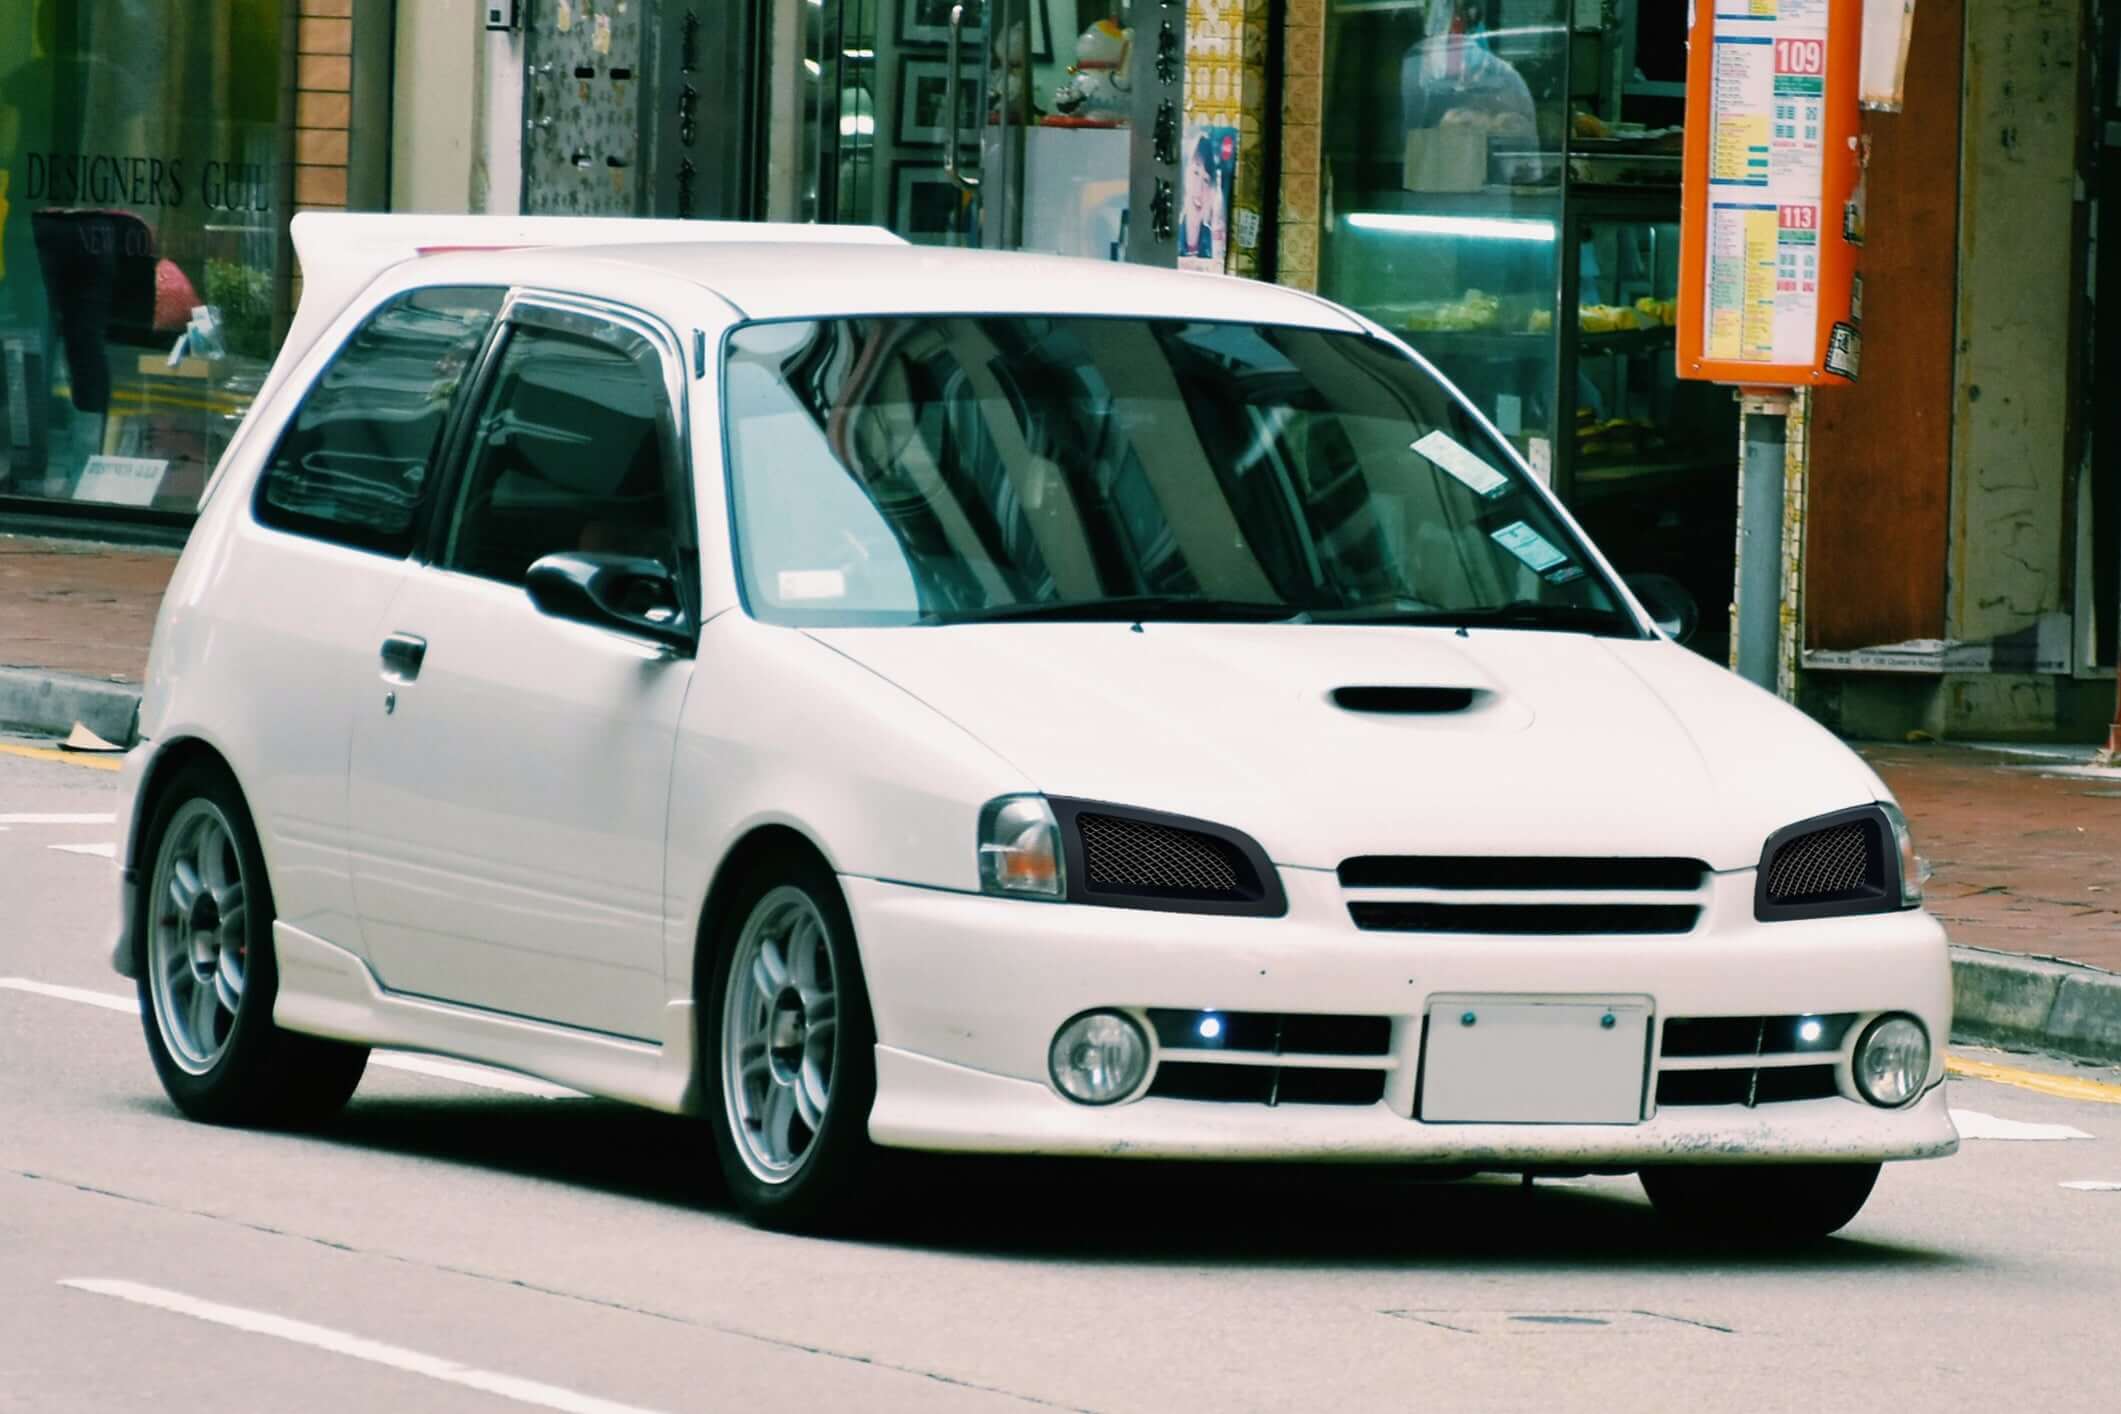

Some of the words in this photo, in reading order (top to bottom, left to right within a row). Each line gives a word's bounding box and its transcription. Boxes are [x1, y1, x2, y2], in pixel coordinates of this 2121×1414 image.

[1777, 38, 1821, 73] 109
[26, 151, 185, 208] DESIGNERS
[1782, 206, 1813, 228] 113
